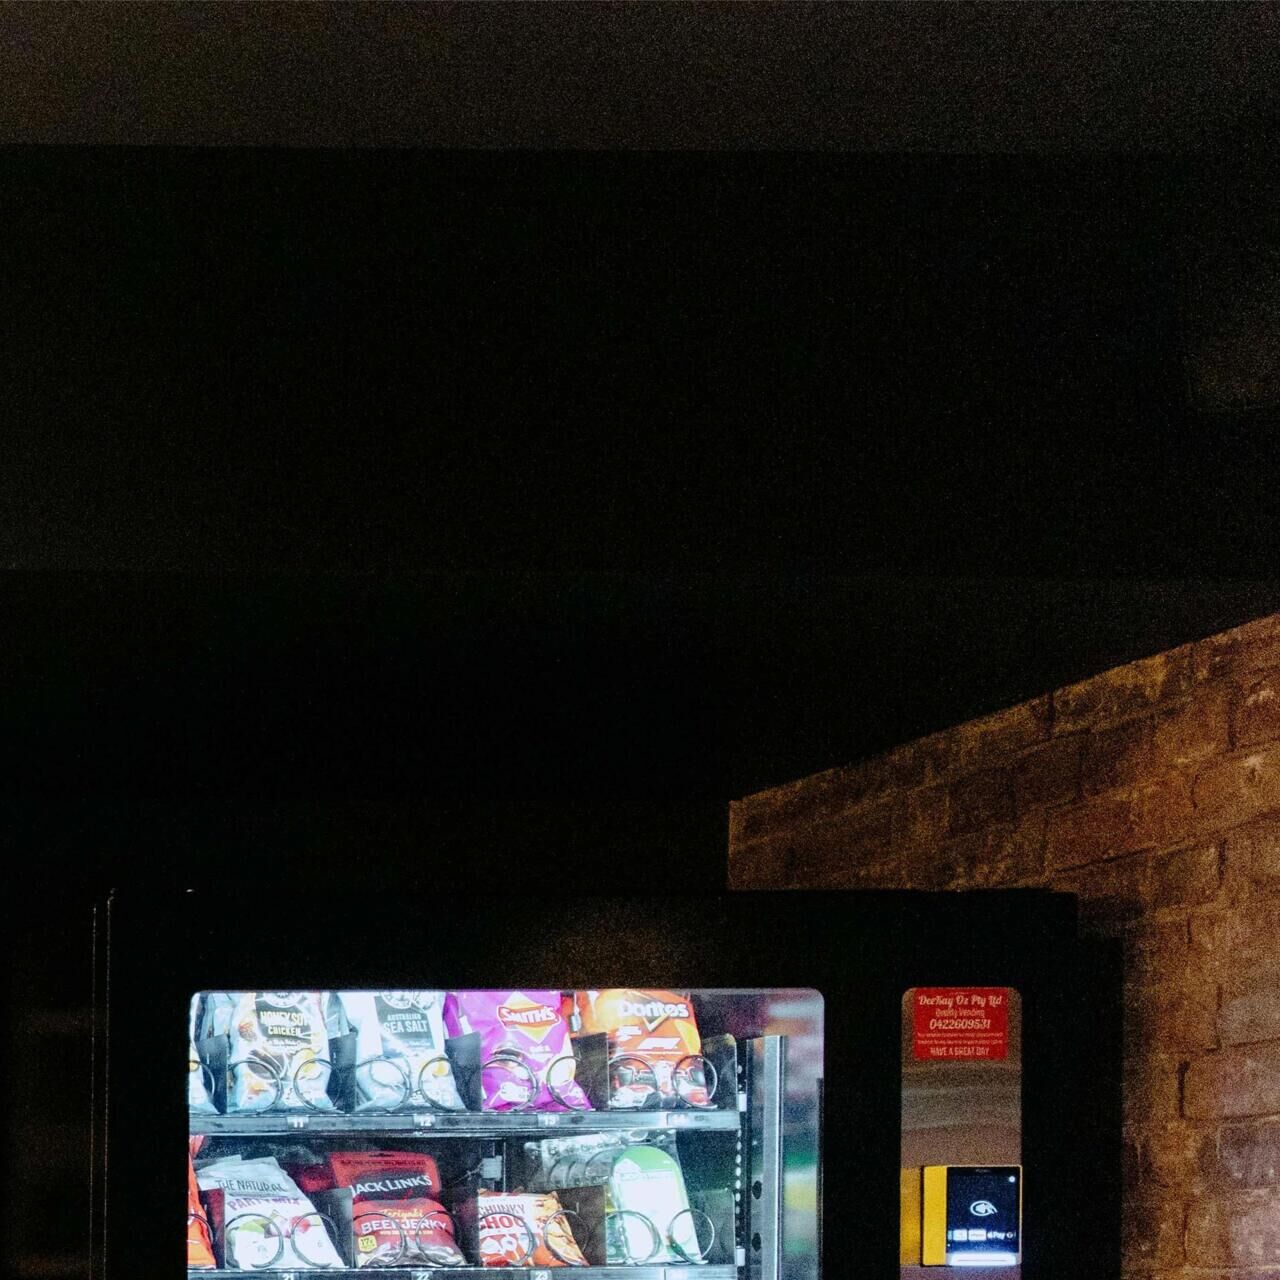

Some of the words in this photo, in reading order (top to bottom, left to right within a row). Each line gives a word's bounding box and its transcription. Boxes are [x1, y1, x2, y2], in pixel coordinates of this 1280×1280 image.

[618, 1001, 690, 1018] Doritos
[267, 1025, 302, 1036] CHICKEN
[383, 1021, 404, 1034] SEA
[404, 1020, 428, 1033] SALT
[294, 1119, 304, 1128] 11
[215, 1179, 235, 1191] THE
[349, 1182, 388, 1198] JACK
[360, 1219, 400, 1235] BEEF
[401, 1218, 447, 1231] JERKY
[535, 1271, 549, 1280] 23
